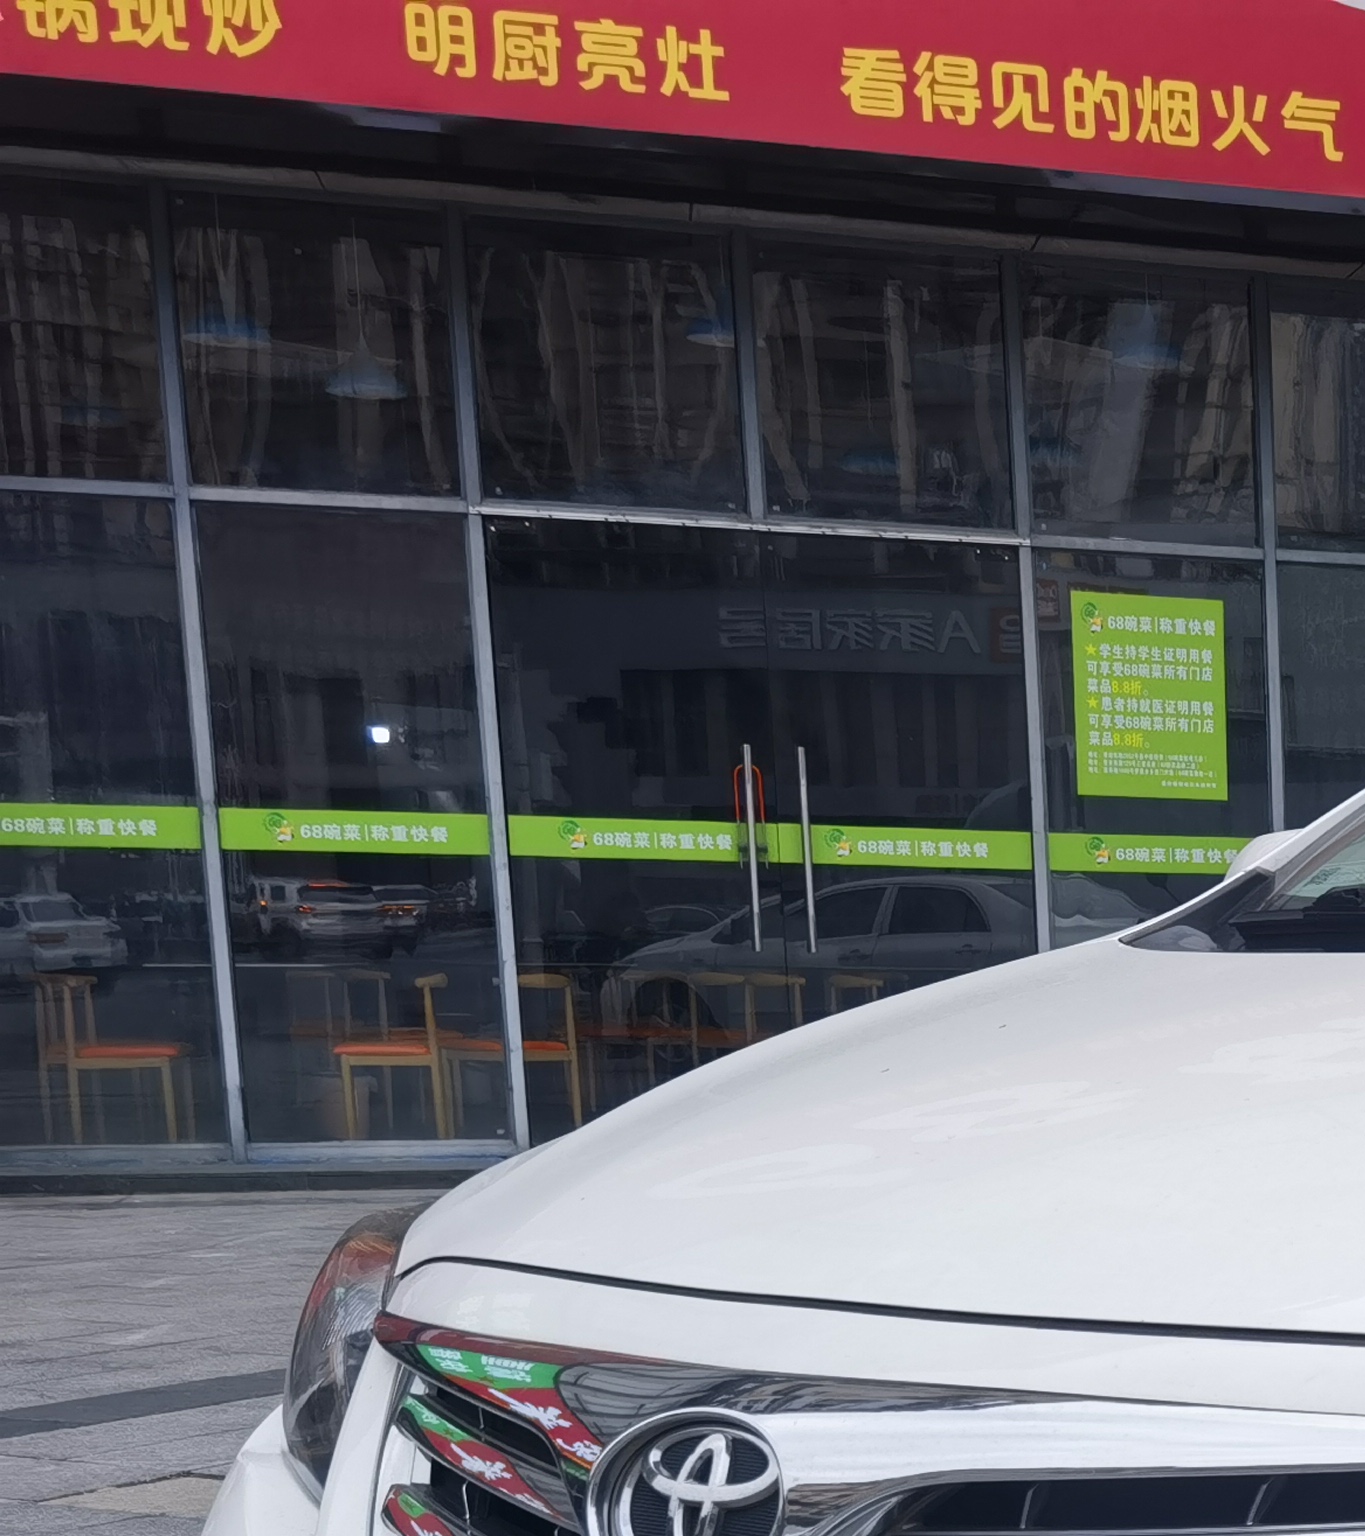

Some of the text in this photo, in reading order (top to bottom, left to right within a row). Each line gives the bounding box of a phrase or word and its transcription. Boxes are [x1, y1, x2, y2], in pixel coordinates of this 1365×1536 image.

[405, 3, 730, 102] 明厨亮灶
[840, 46, 1344, 163] 看得见的烟火气
[1099, 643, 1213, 664] 学生持学生证明用餐
[1086, 660, 1213, 682] 可享受68碗菜所有门店
[1088, 713, 1215, 734] 可享受68碗菜所有门店
